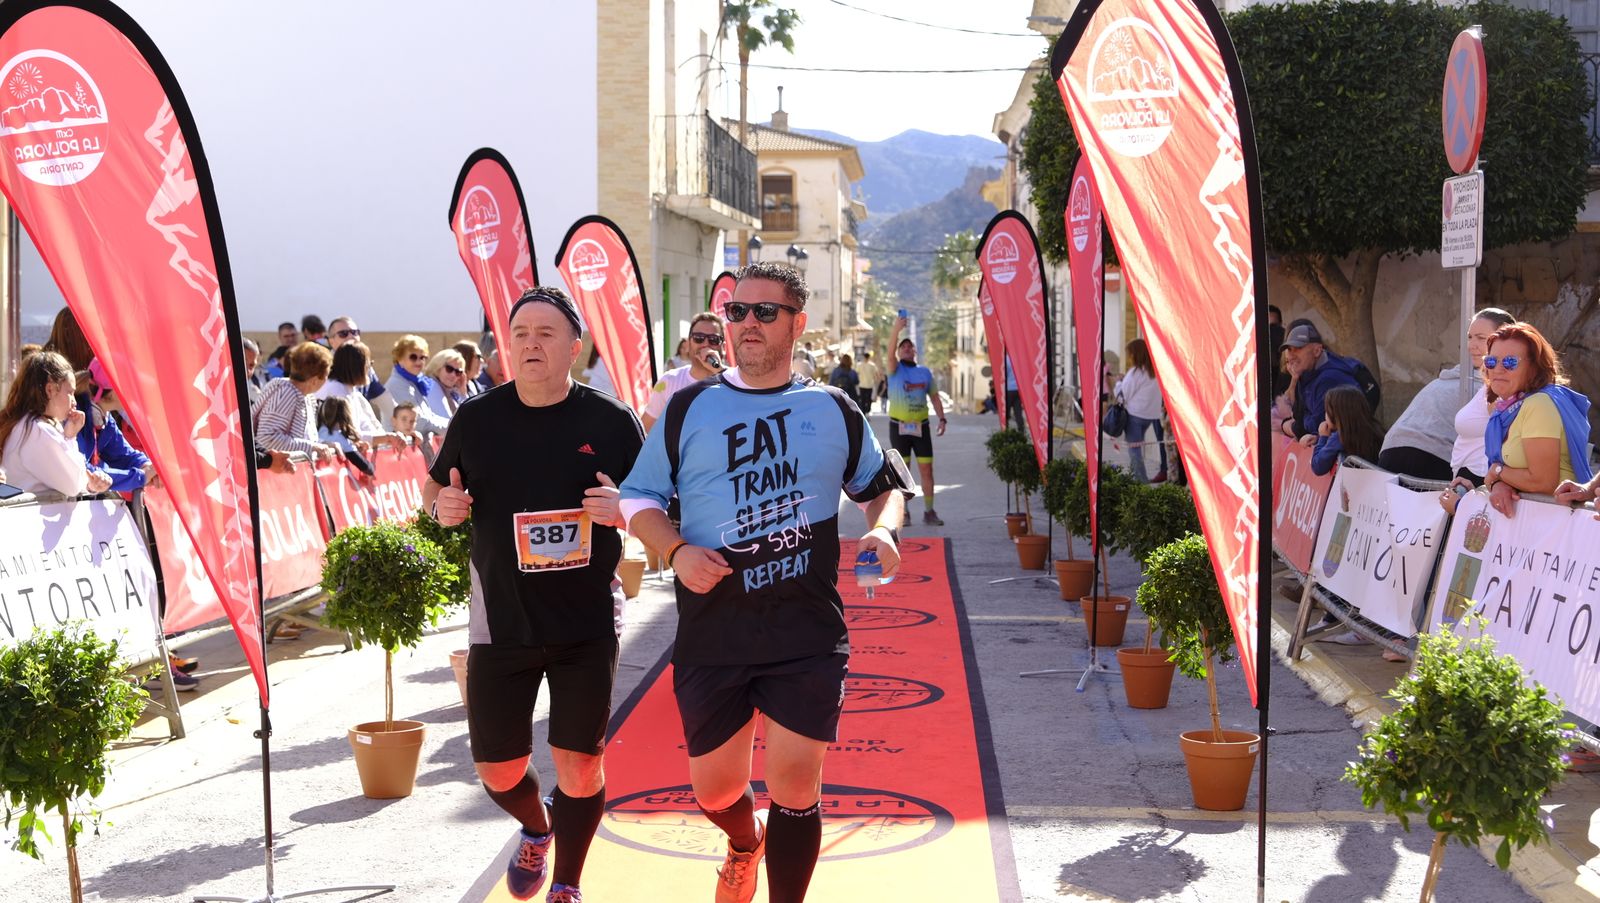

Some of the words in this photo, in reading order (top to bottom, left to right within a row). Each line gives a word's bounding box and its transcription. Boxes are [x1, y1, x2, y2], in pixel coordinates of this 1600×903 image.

[722, 408, 791, 473] EAT
[729, 457, 798, 505] TRAIN
[530, 523, 578, 545] 387
[736, 490, 804, 539] SLEEP
[768, 512, 813, 552] SEX!!
[99, 538, 128, 561] DE
[742, 549, 811, 593] REPEAT
[1474, 576, 1600, 664] CANTO
